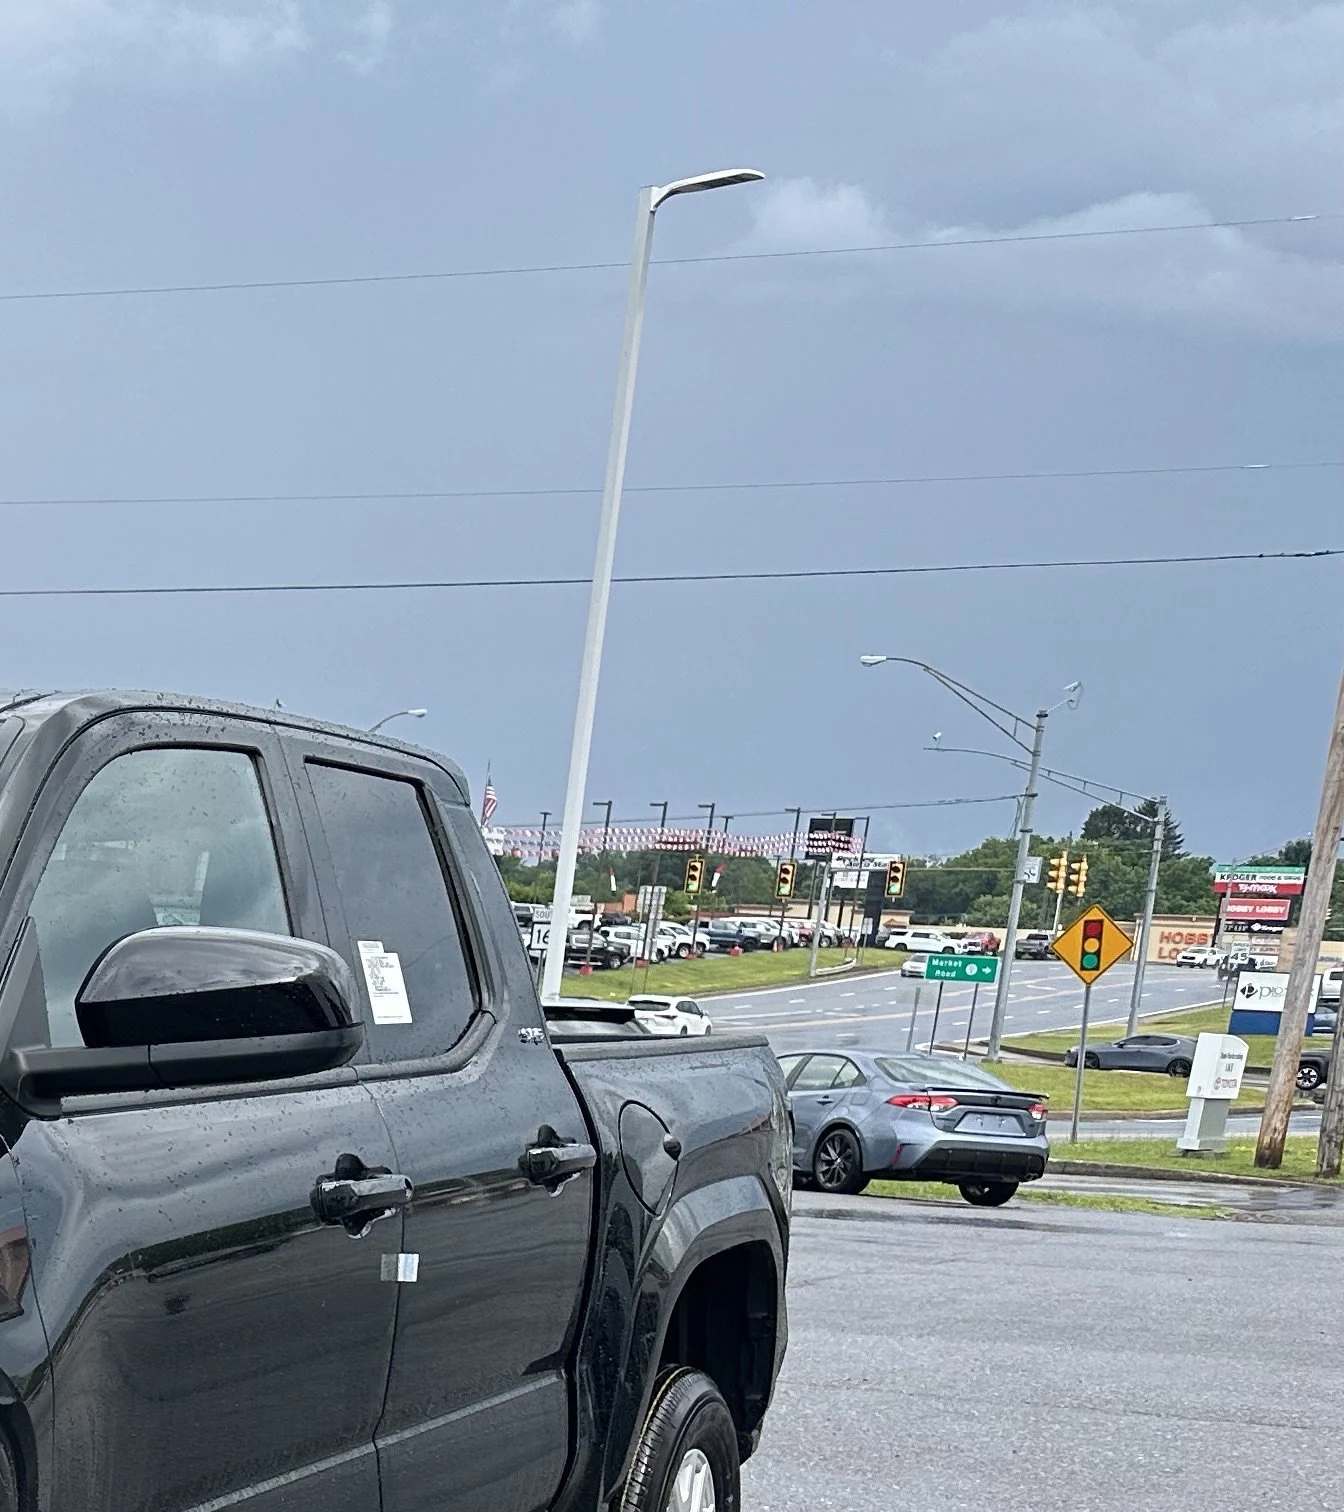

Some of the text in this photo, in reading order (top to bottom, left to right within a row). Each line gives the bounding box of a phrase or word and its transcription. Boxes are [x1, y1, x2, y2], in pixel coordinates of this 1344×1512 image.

[1220, 873, 1257, 881] KROGER
[1255, 906, 1286, 914] LOBBY
[1159, 931, 1210, 945] HOBB
[1230, 952, 1249, 961] 45
[932, 958, 962, 967] Market
